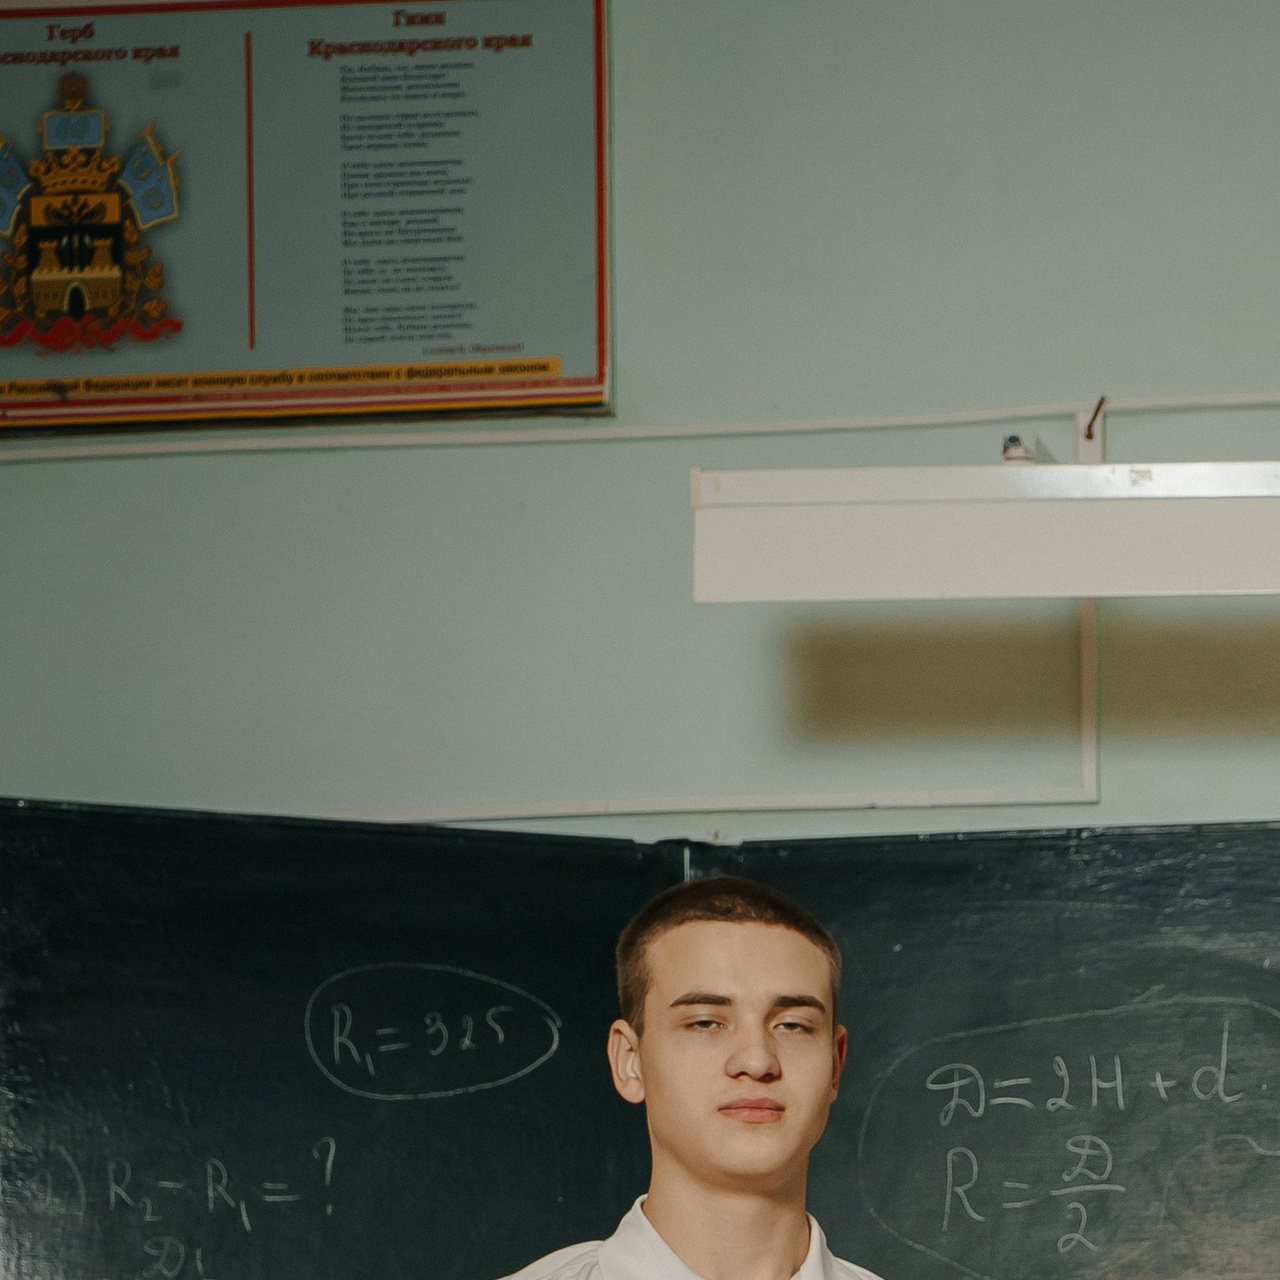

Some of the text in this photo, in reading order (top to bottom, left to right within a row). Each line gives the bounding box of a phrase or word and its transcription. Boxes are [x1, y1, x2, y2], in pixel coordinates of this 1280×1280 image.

[46, 21, 95, 43] Герб
[0, 45, 180, 66] снодарского края
[307, 34, 533, 59] Краснодарского края
